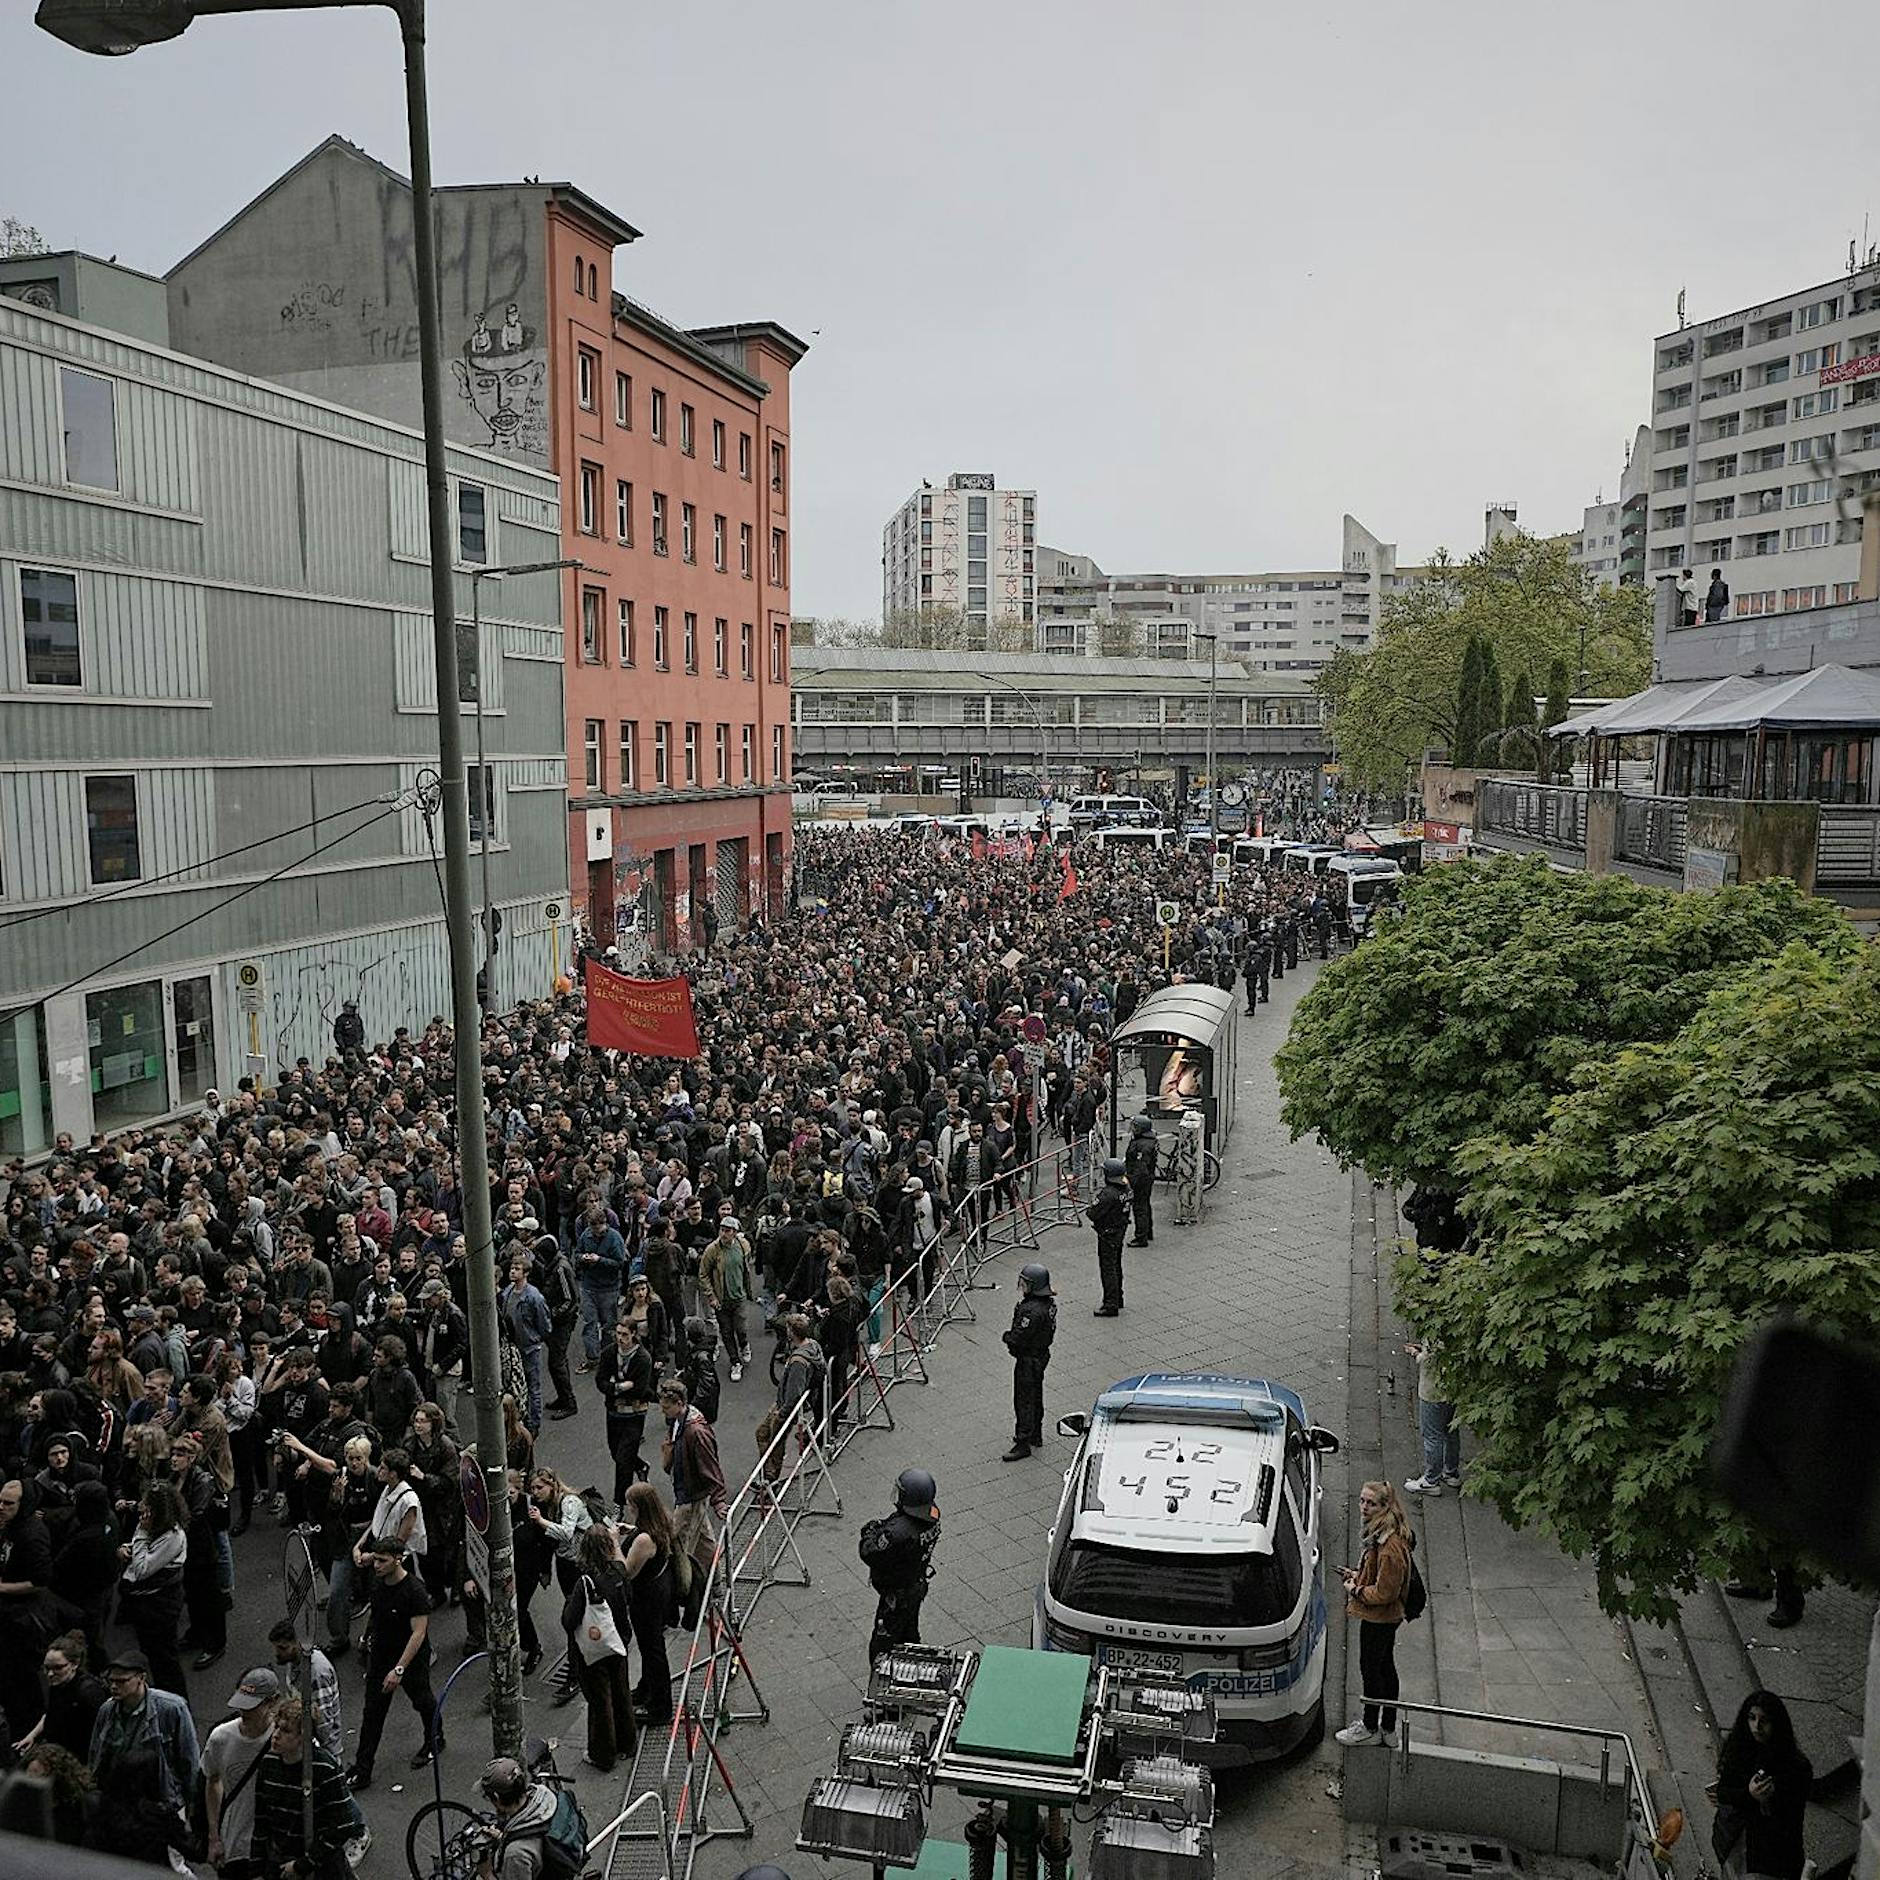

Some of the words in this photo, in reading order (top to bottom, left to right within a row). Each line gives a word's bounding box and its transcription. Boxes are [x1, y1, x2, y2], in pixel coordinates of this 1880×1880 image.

[1105, 1624, 1227, 1642] DISCOVERY
[1107, 1649, 1126, 1666] BP
[1132, 1652, 1181, 1671] 22-452
[1207, 1675, 1276, 1692] POLIZEI
